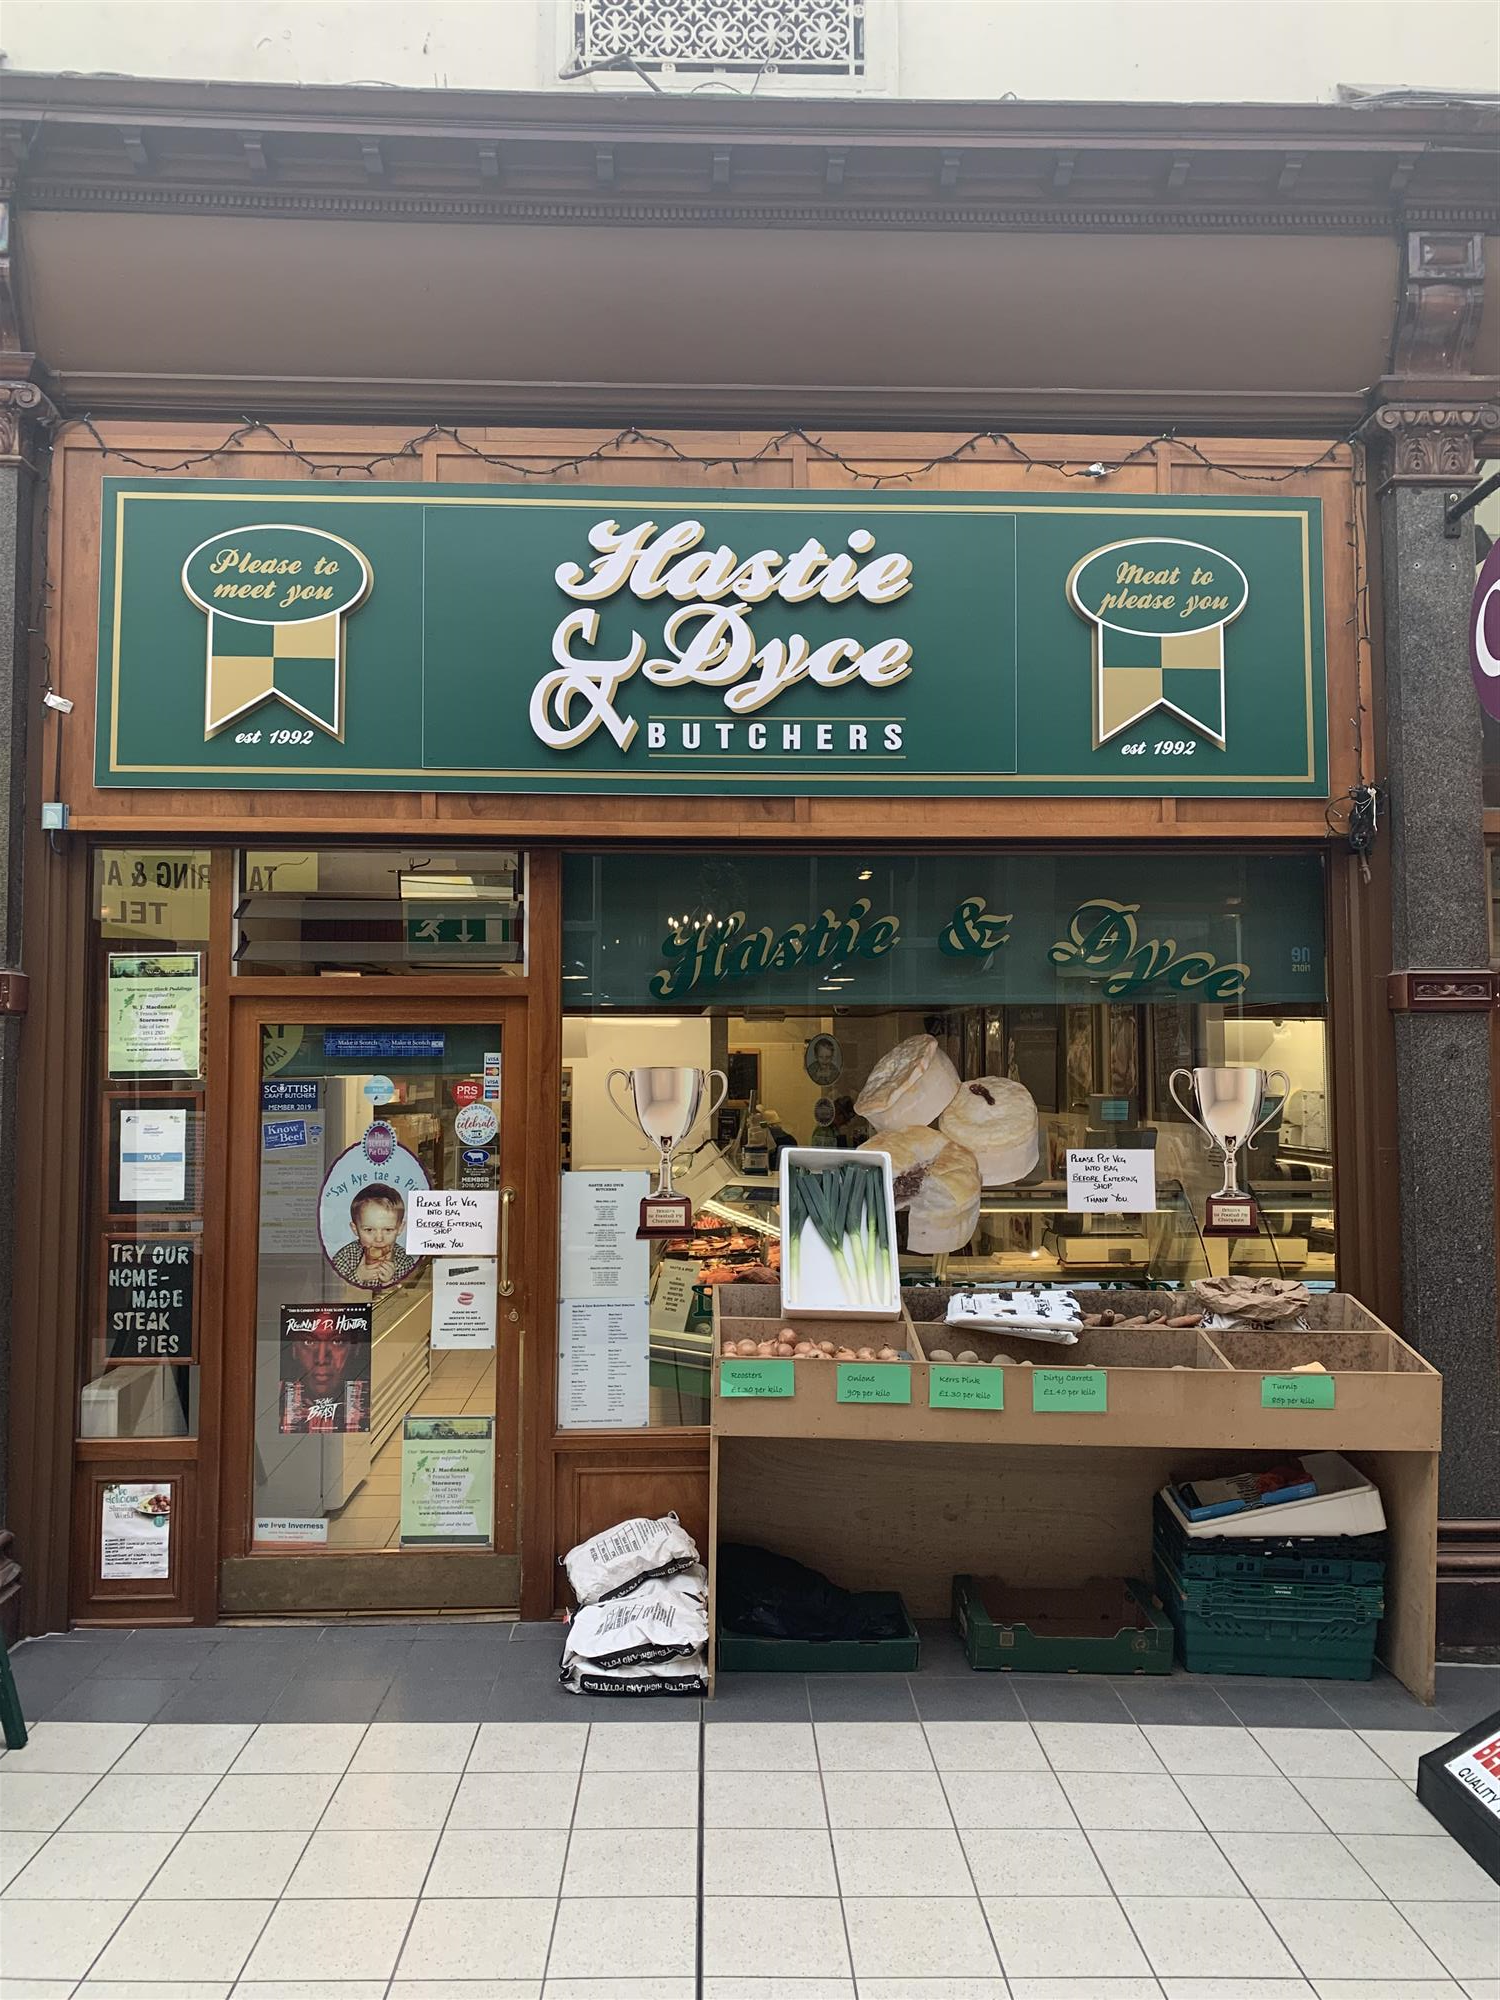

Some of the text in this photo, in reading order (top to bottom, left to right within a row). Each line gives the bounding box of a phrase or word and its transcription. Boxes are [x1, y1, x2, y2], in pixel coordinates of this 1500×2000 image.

[210, 549, 340, 576] Please to
[554, 519, 912, 604] Hastie
[1116, 561, 1214, 586] Meat to
[213, 580, 334, 608] meet you
[1096, 588, 1229, 618] please you
[529, 602, 912, 752] & Dyce
[235, 730, 314, 745] est 1992
[648, 721, 904, 751] BUTCHERS
[1121, 740, 1197, 756] est 1992
[649, 896, 1251, 1002] Hastie & Dyce
[264, 1084, 316, 1093] SCOTTISH
[456, 1085, 478, 1095] PRS
[461, 1105, 492, 1116] INVERNESS
[457, 1115, 495, 1129] celebrate
[280, 1130, 304, 1143] Beef
[143, 1153, 162, 1161] PASS
[377, 1148, 390, 1156] Club
[1070, 1153, 1127, 1164] PLEASE PUT VEG
[351, 1173, 368, 1186] Aye
[374, 1171, 389, 1181] tae
[394, 1175, 400, 1184] a
[1072, 1174, 1138, 1184] BEFORE ENTERING
[416, 1195, 478, 1208] PLEASE PUT VEG
[1084, 1194, 1109, 1203] THANK
[445, 1208, 461, 1217] BAG
[416, 1218, 483, 1229] BEFORE ENTERING
[421, 1240, 447, 1249] THANK
[111, 1244, 190, 1265] TRY OUR
[108, 1269, 170, 1287] HOME-
[131, 1289, 184, 1309] MADE
[113, 1311, 170, 1331] STEAK
[335, 1314, 368, 1334] HUNTER
[137, 1334, 179, 1354] PIES
[731, 1372, 763, 1380] Roosters
[847, 1374, 876, 1383] Onions
[939, 1376, 981, 1385] Kerrs Pink
[1043, 1374, 1093, 1384] Dirty Carrots
[754, 1386, 767, 1395] per
[768, 1385, 783, 1394] kilo
[862, 1390, 874, 1398] per
[875, 1388, 891, 1397] kilo
[1067, 1389, 1080, 1397] per
[1081, 1388, 1096, 1396] kilo
[1271, 1383, 1298, 1392] Turnip
[962, 1391, 975, 1400] per
[975, 1390, 991, 1400] kilo
[1299, 1397, 1315, 1405] kilo
[305, 1402, 343, 1423] BEAST
[584, 1680, 625, 1692] POTATOES
[626, 1682, 662, 1693] HIGHLAND
[1458, 1767, 1500, 1805] QUALITY
